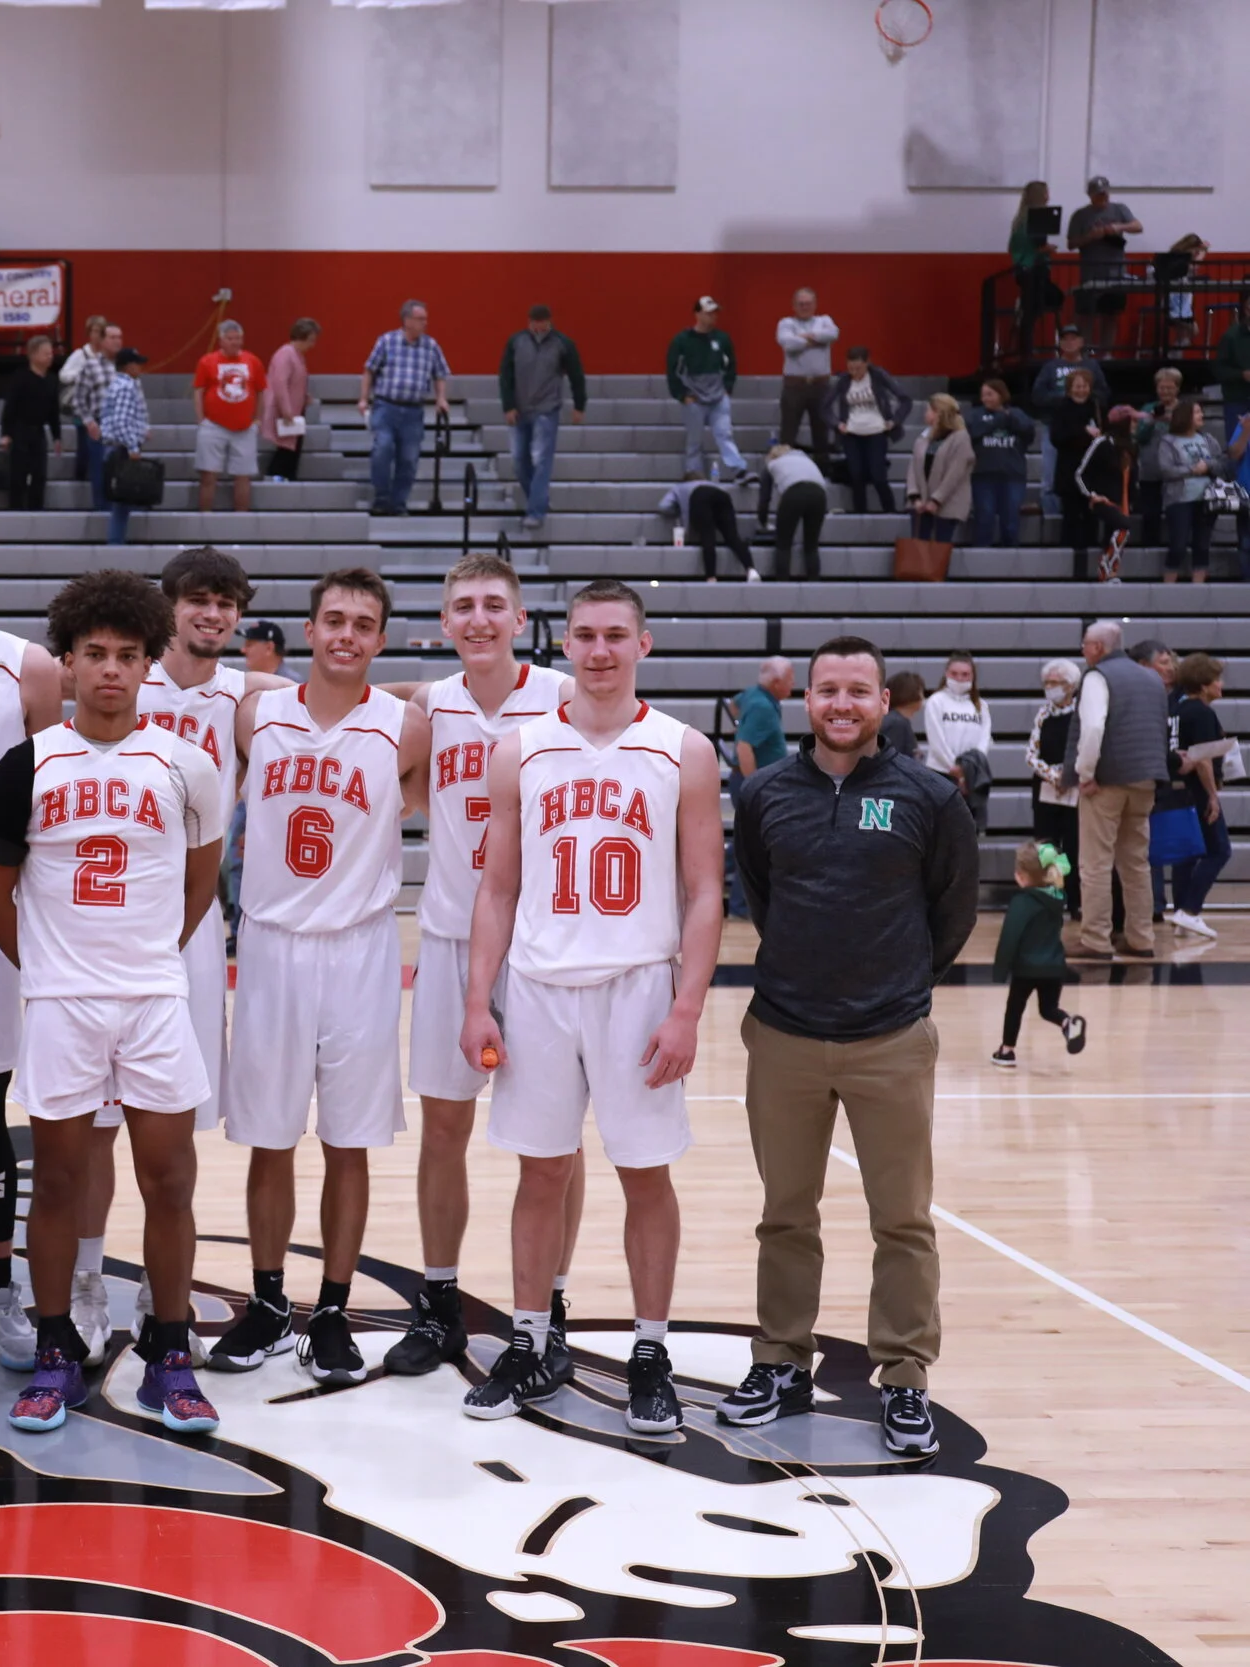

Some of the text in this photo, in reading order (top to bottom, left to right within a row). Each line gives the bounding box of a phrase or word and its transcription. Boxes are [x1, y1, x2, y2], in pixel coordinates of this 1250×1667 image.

[262, 755, 370, 815] HBCA
[437, 741, 500, 792] HB
[39, 778, 166, 834] HBCA
[540, 778, 653, 840] HBCA
[859, 797, 895, 831] N
[73, 835, 128, 907] 2
[285, 805, 334, 879] 6
[552, 836, 641, 916] 10
